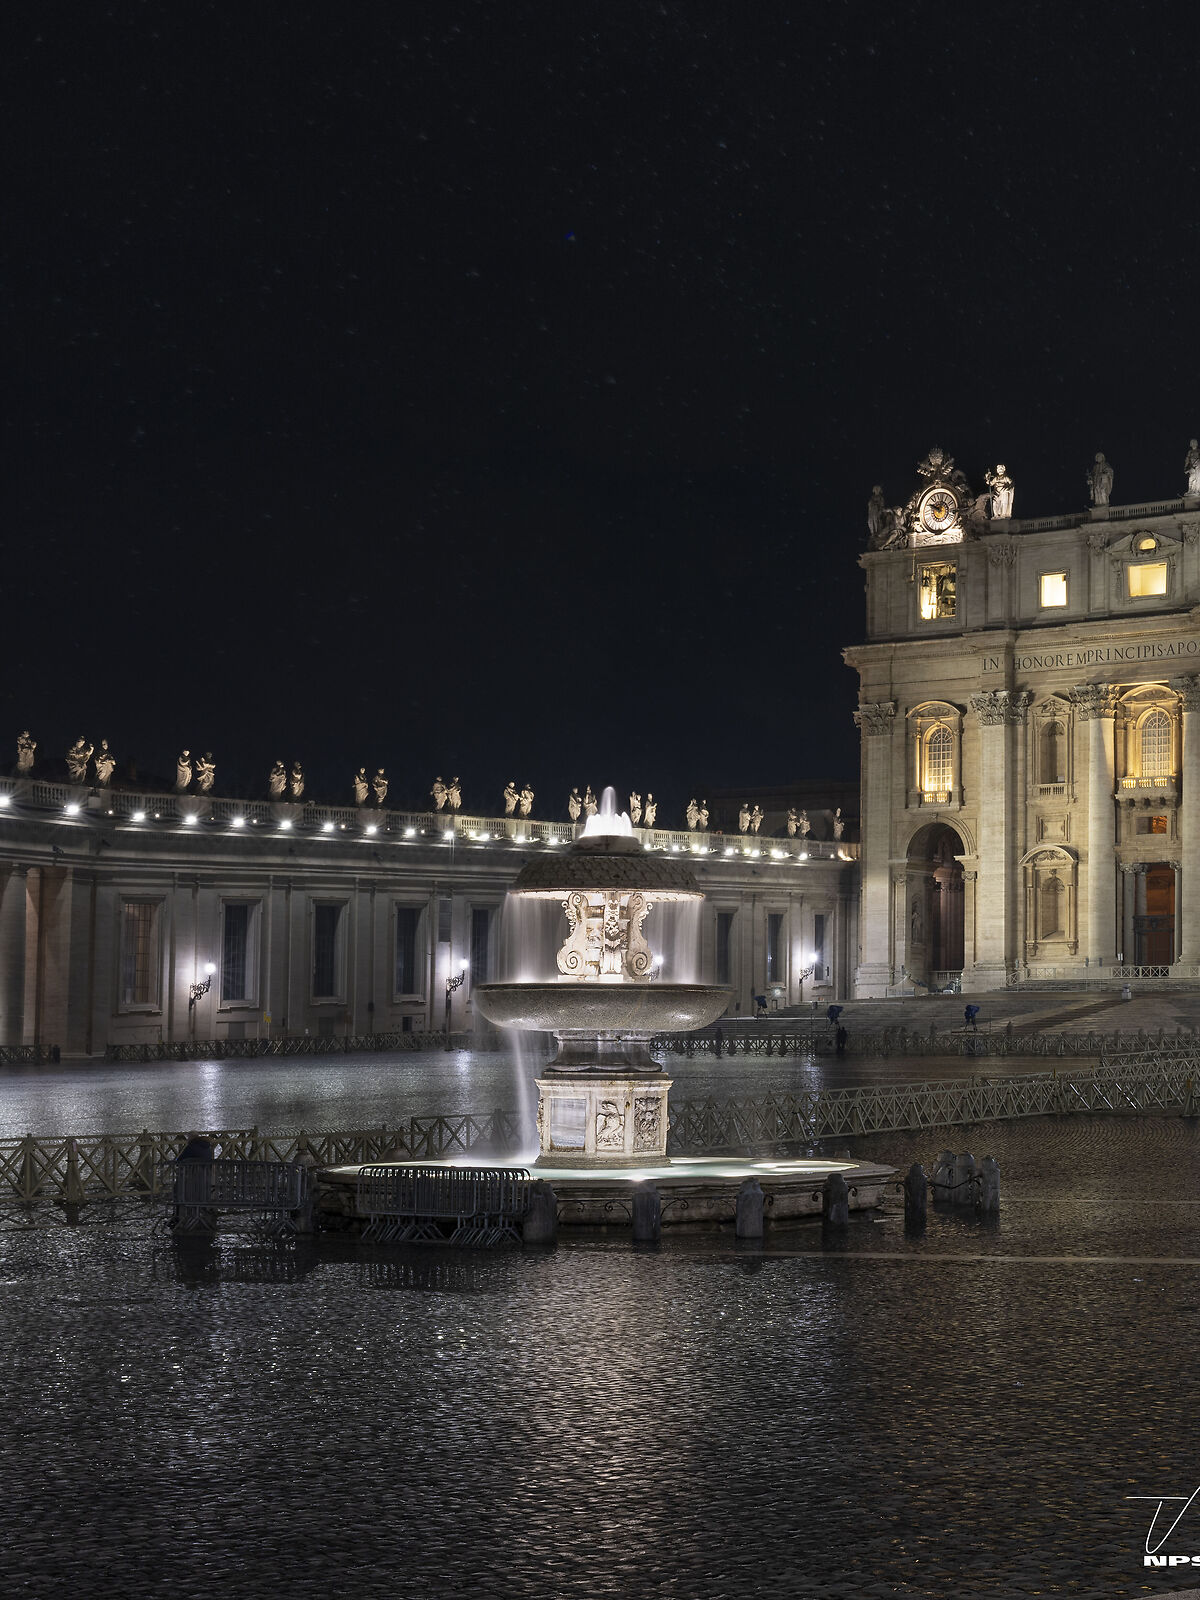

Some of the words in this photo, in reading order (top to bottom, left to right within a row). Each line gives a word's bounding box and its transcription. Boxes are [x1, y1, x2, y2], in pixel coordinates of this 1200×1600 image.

[983, 657, 999, 670] IN
[1014, 652, 1087, 670] HONOREM
[1087, 644, 1164, 662] PRINCIPIS
